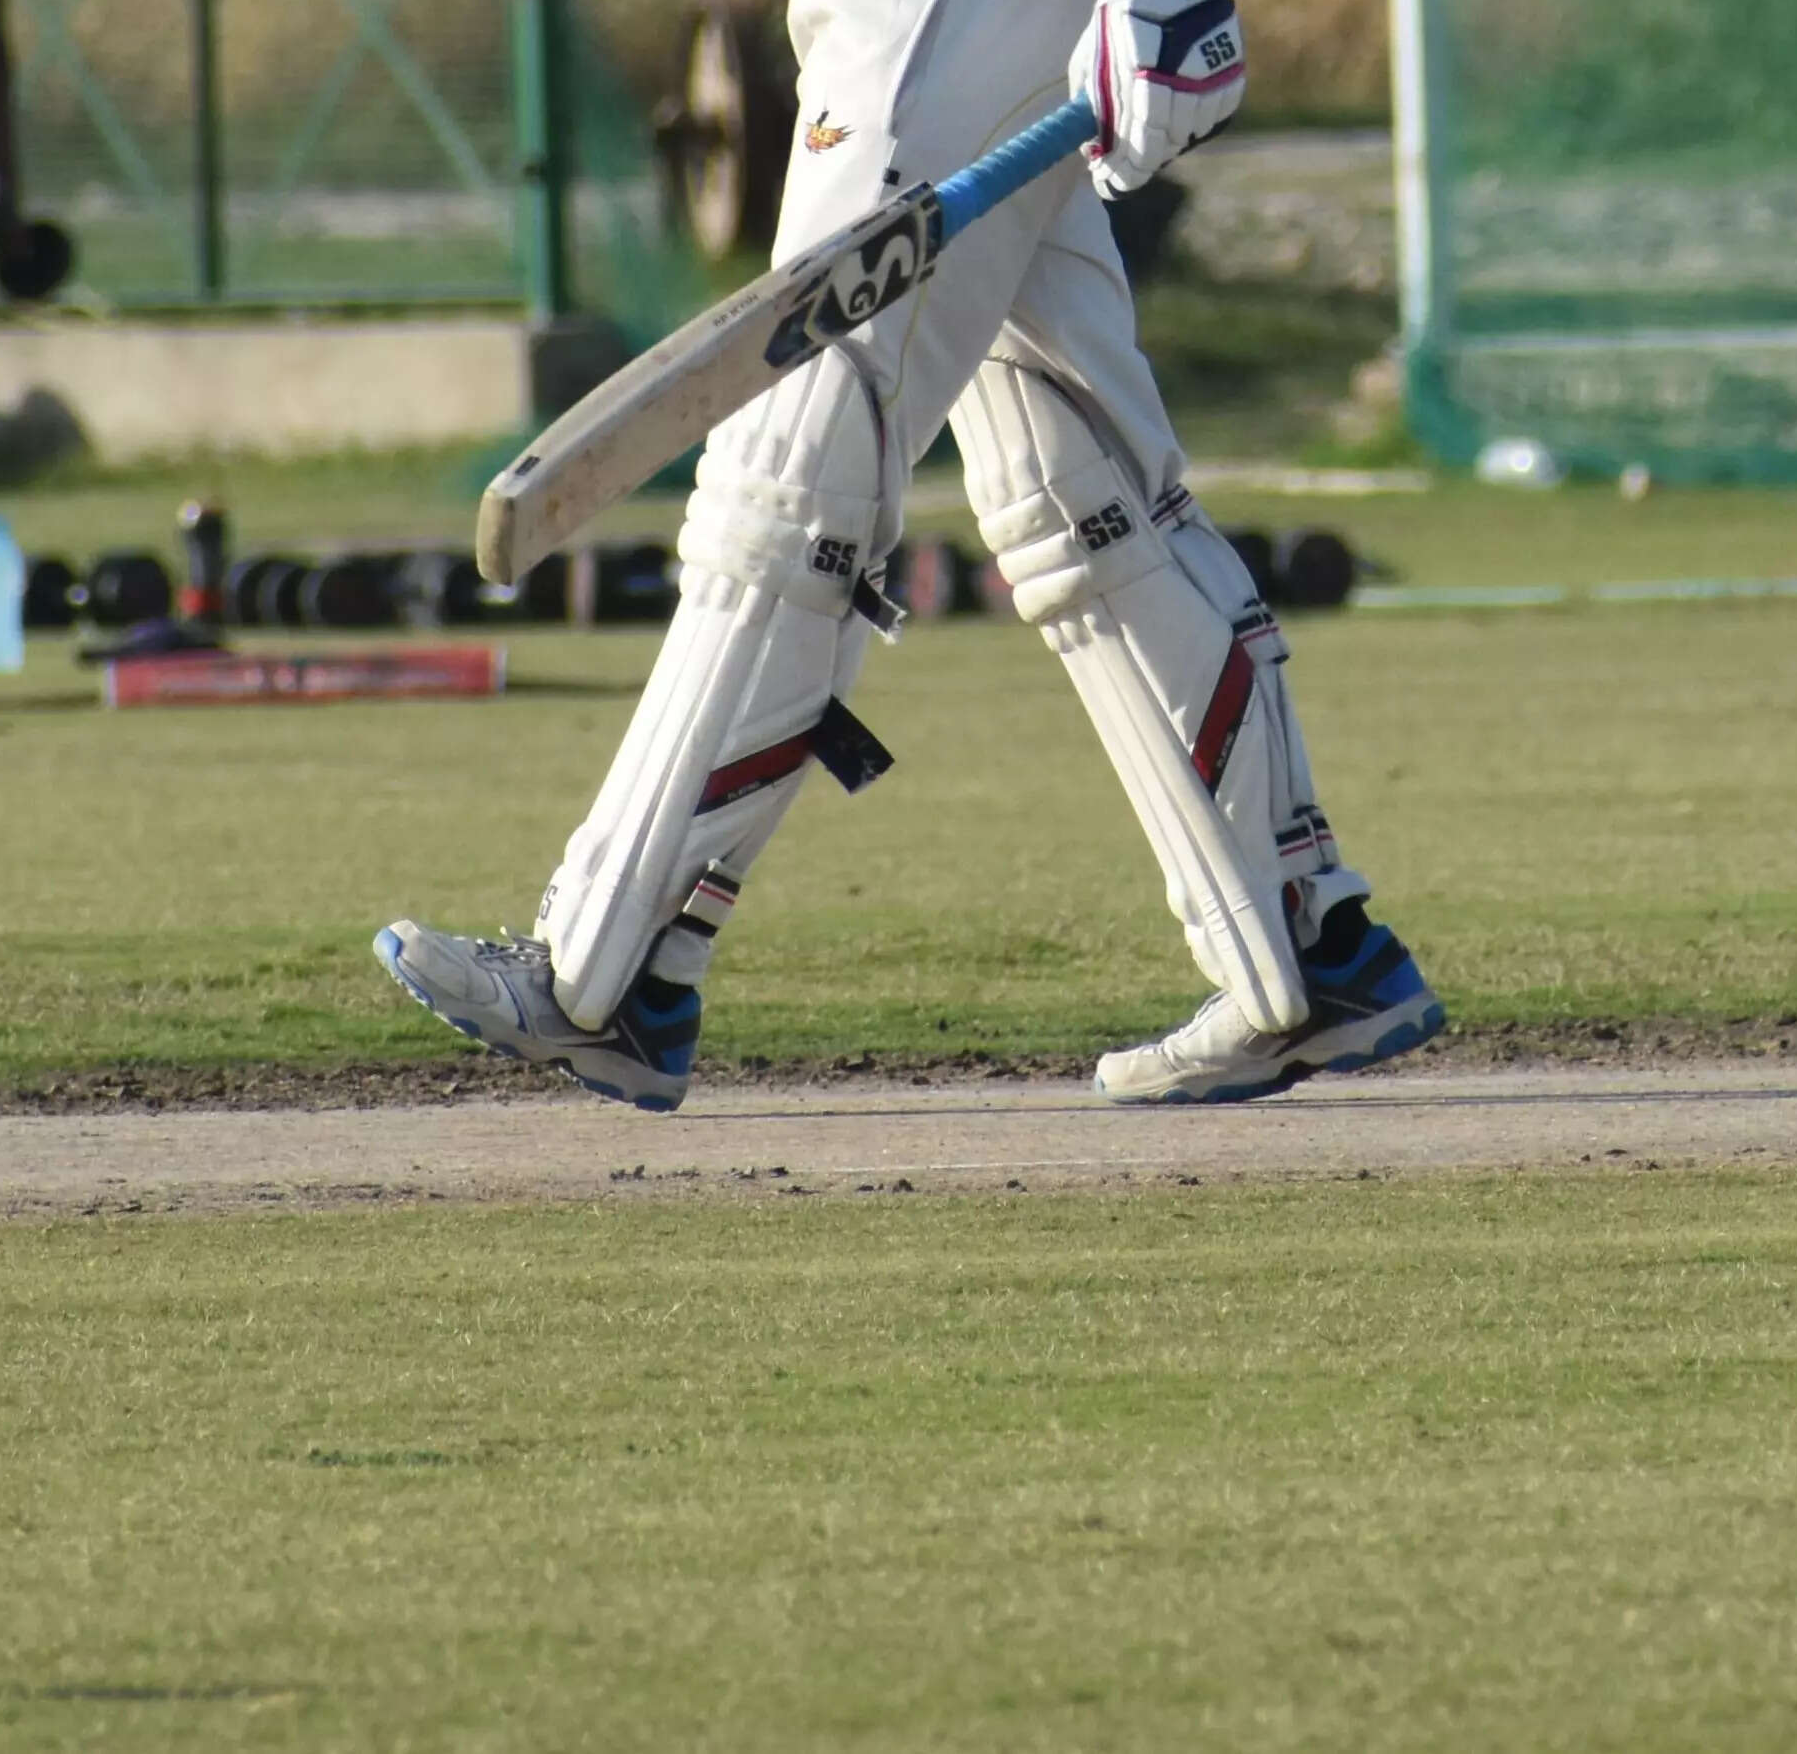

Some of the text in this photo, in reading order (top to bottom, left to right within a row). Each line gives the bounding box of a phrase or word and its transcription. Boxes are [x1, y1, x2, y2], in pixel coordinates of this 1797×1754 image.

[1199, 31, 1236, 70] SS
[1079, 502, 1131, 551] SS
[814, 538, 858, 576] SS
